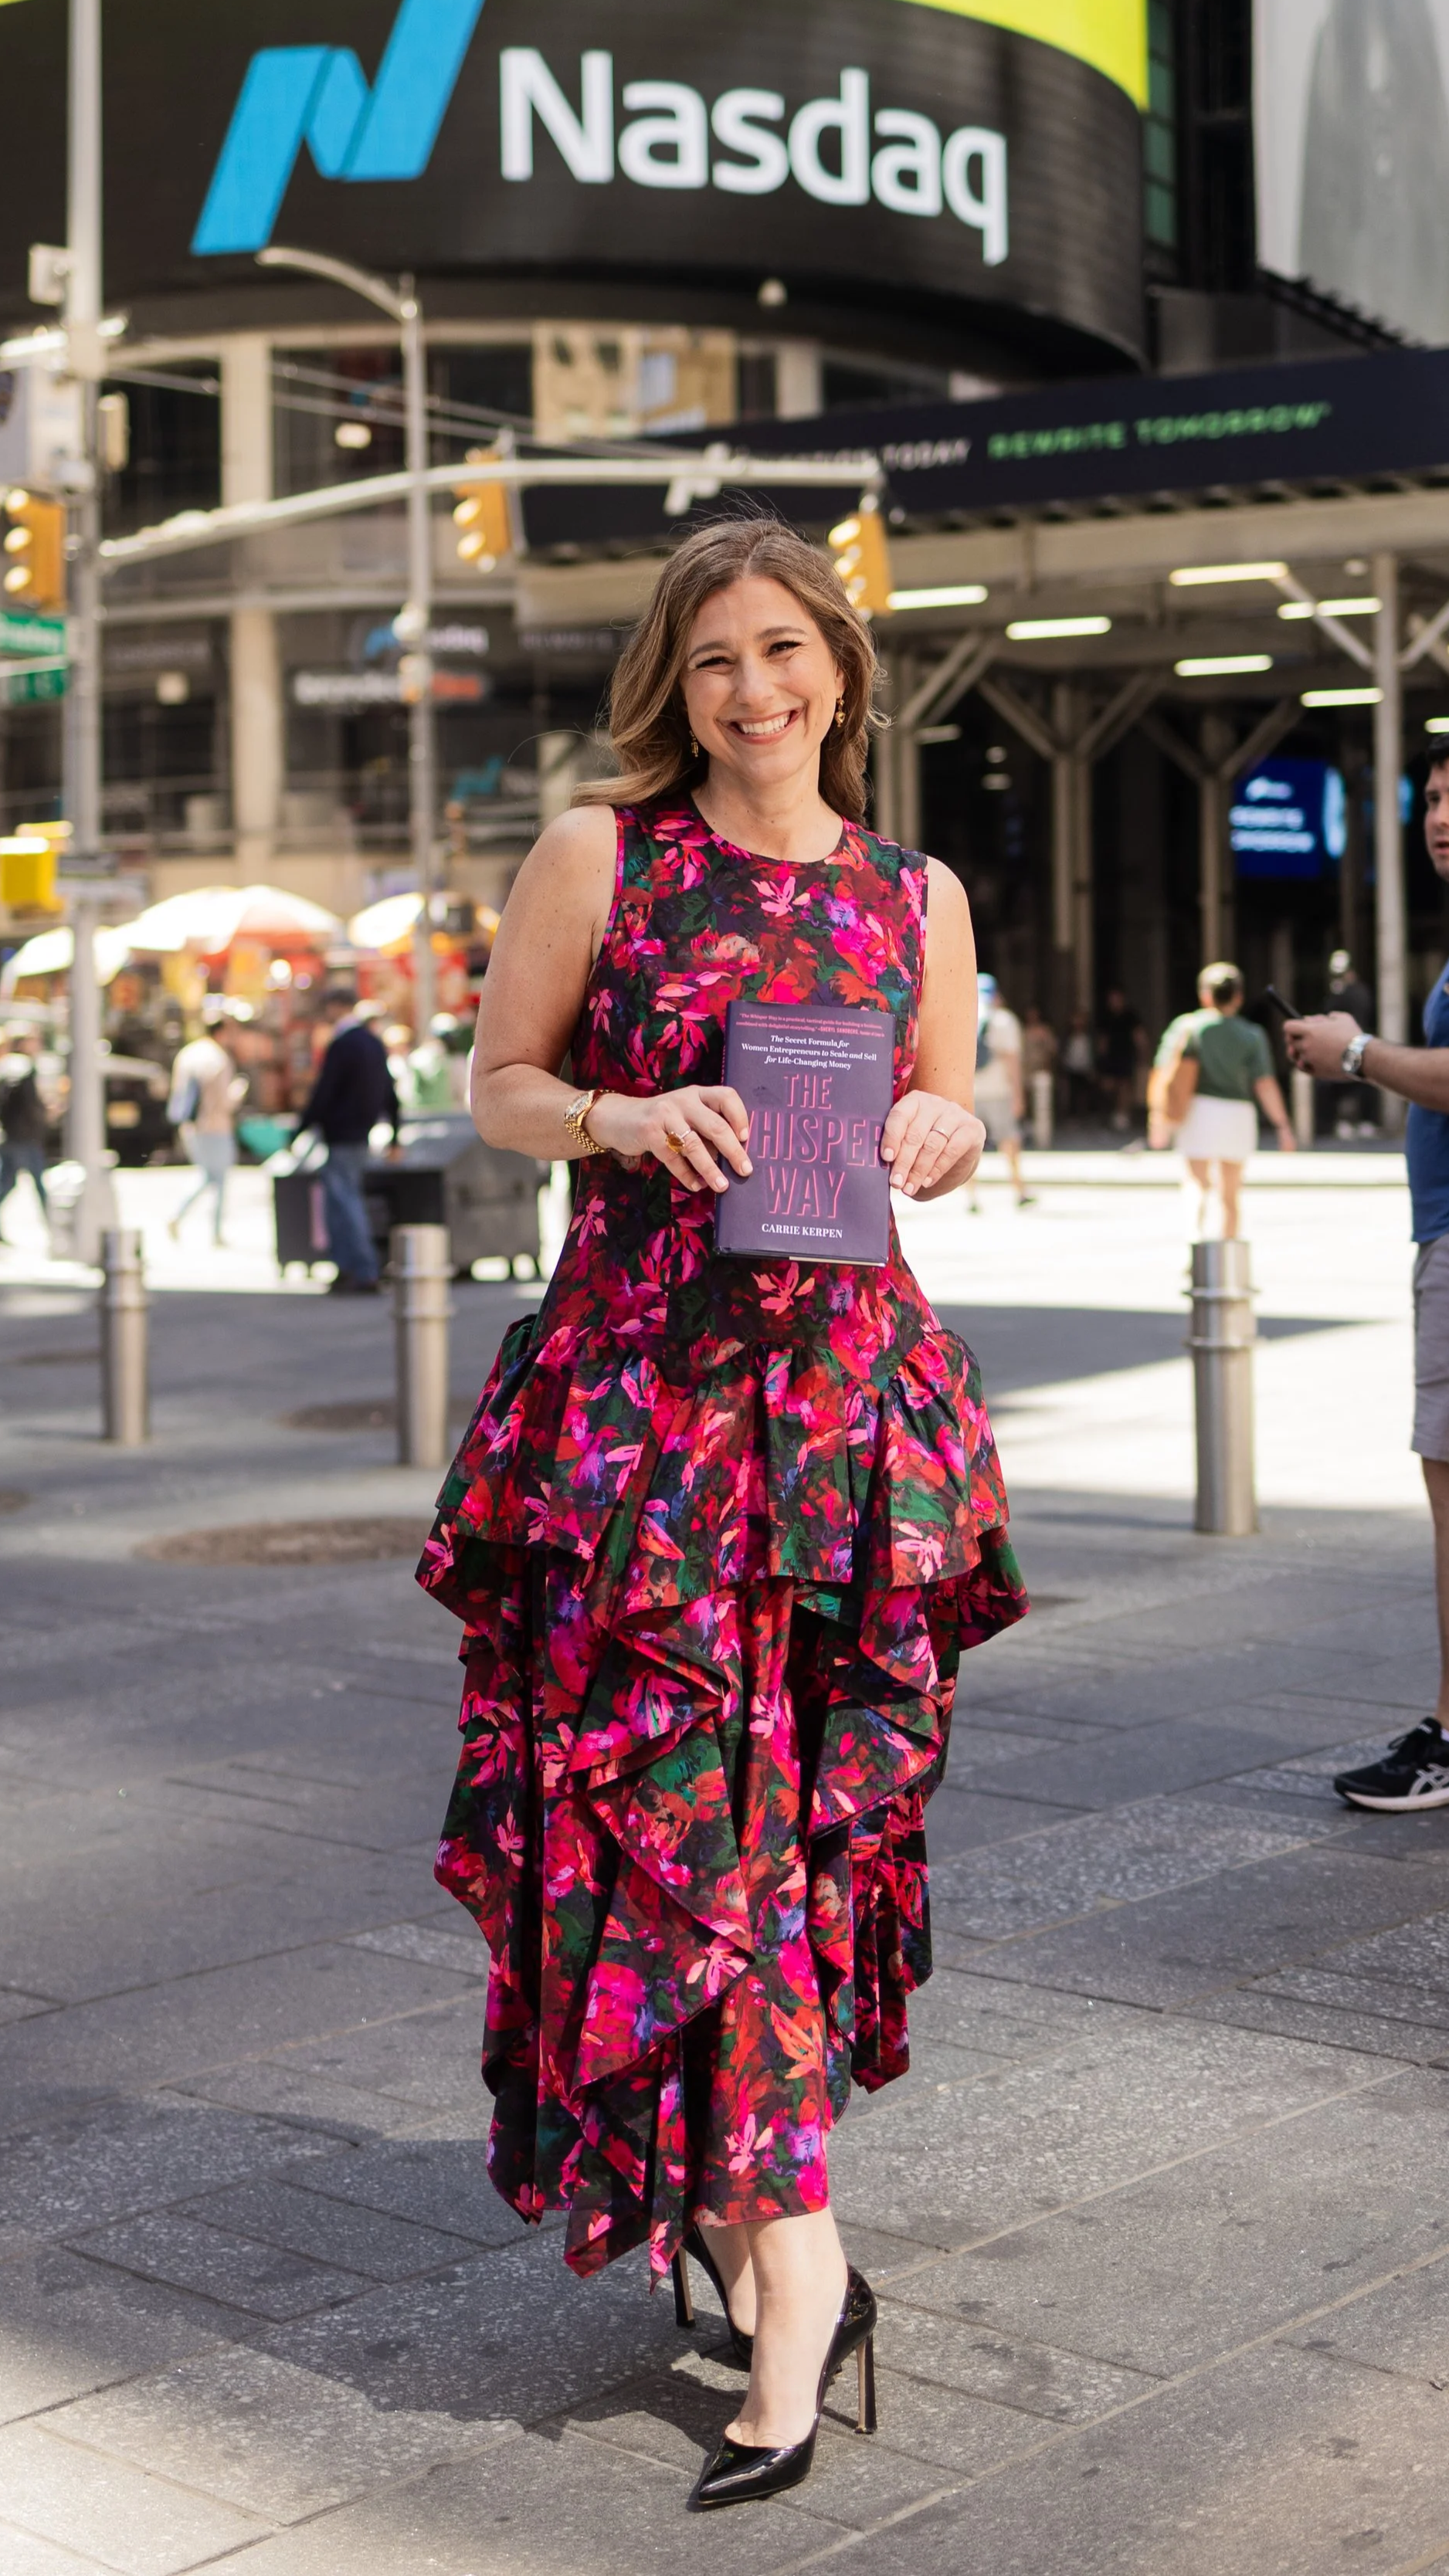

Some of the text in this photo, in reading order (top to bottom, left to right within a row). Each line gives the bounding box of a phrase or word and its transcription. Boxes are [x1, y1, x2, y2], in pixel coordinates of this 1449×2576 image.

[499, 46, 1009, 267] Nasdaq
[987, 421, 1128, 461] REWRITE
[741, 1042, 769, 1052] Women
[769, 1045, 820, 1056] Entrepreneurs
[830, 1049, 848, 1059] Scale
[849, 1052, 864, 1060] and
[864, 1052, 877, 1061] Sell
[785, 1035, 807, 1045] Secret
[808, 1037, 838, 1047] Formula
[836, 1039, 850, 1049] for
[764, 1055, 852, 1071] for Life-Changing Money
[783, 1073, 833, 1110] THE
[745, 1110, 889, 1169] HISPER
[765, 1165, 846, 1219] WAY
[761, 1223, 843, 1239] CARRIE KERPEN
